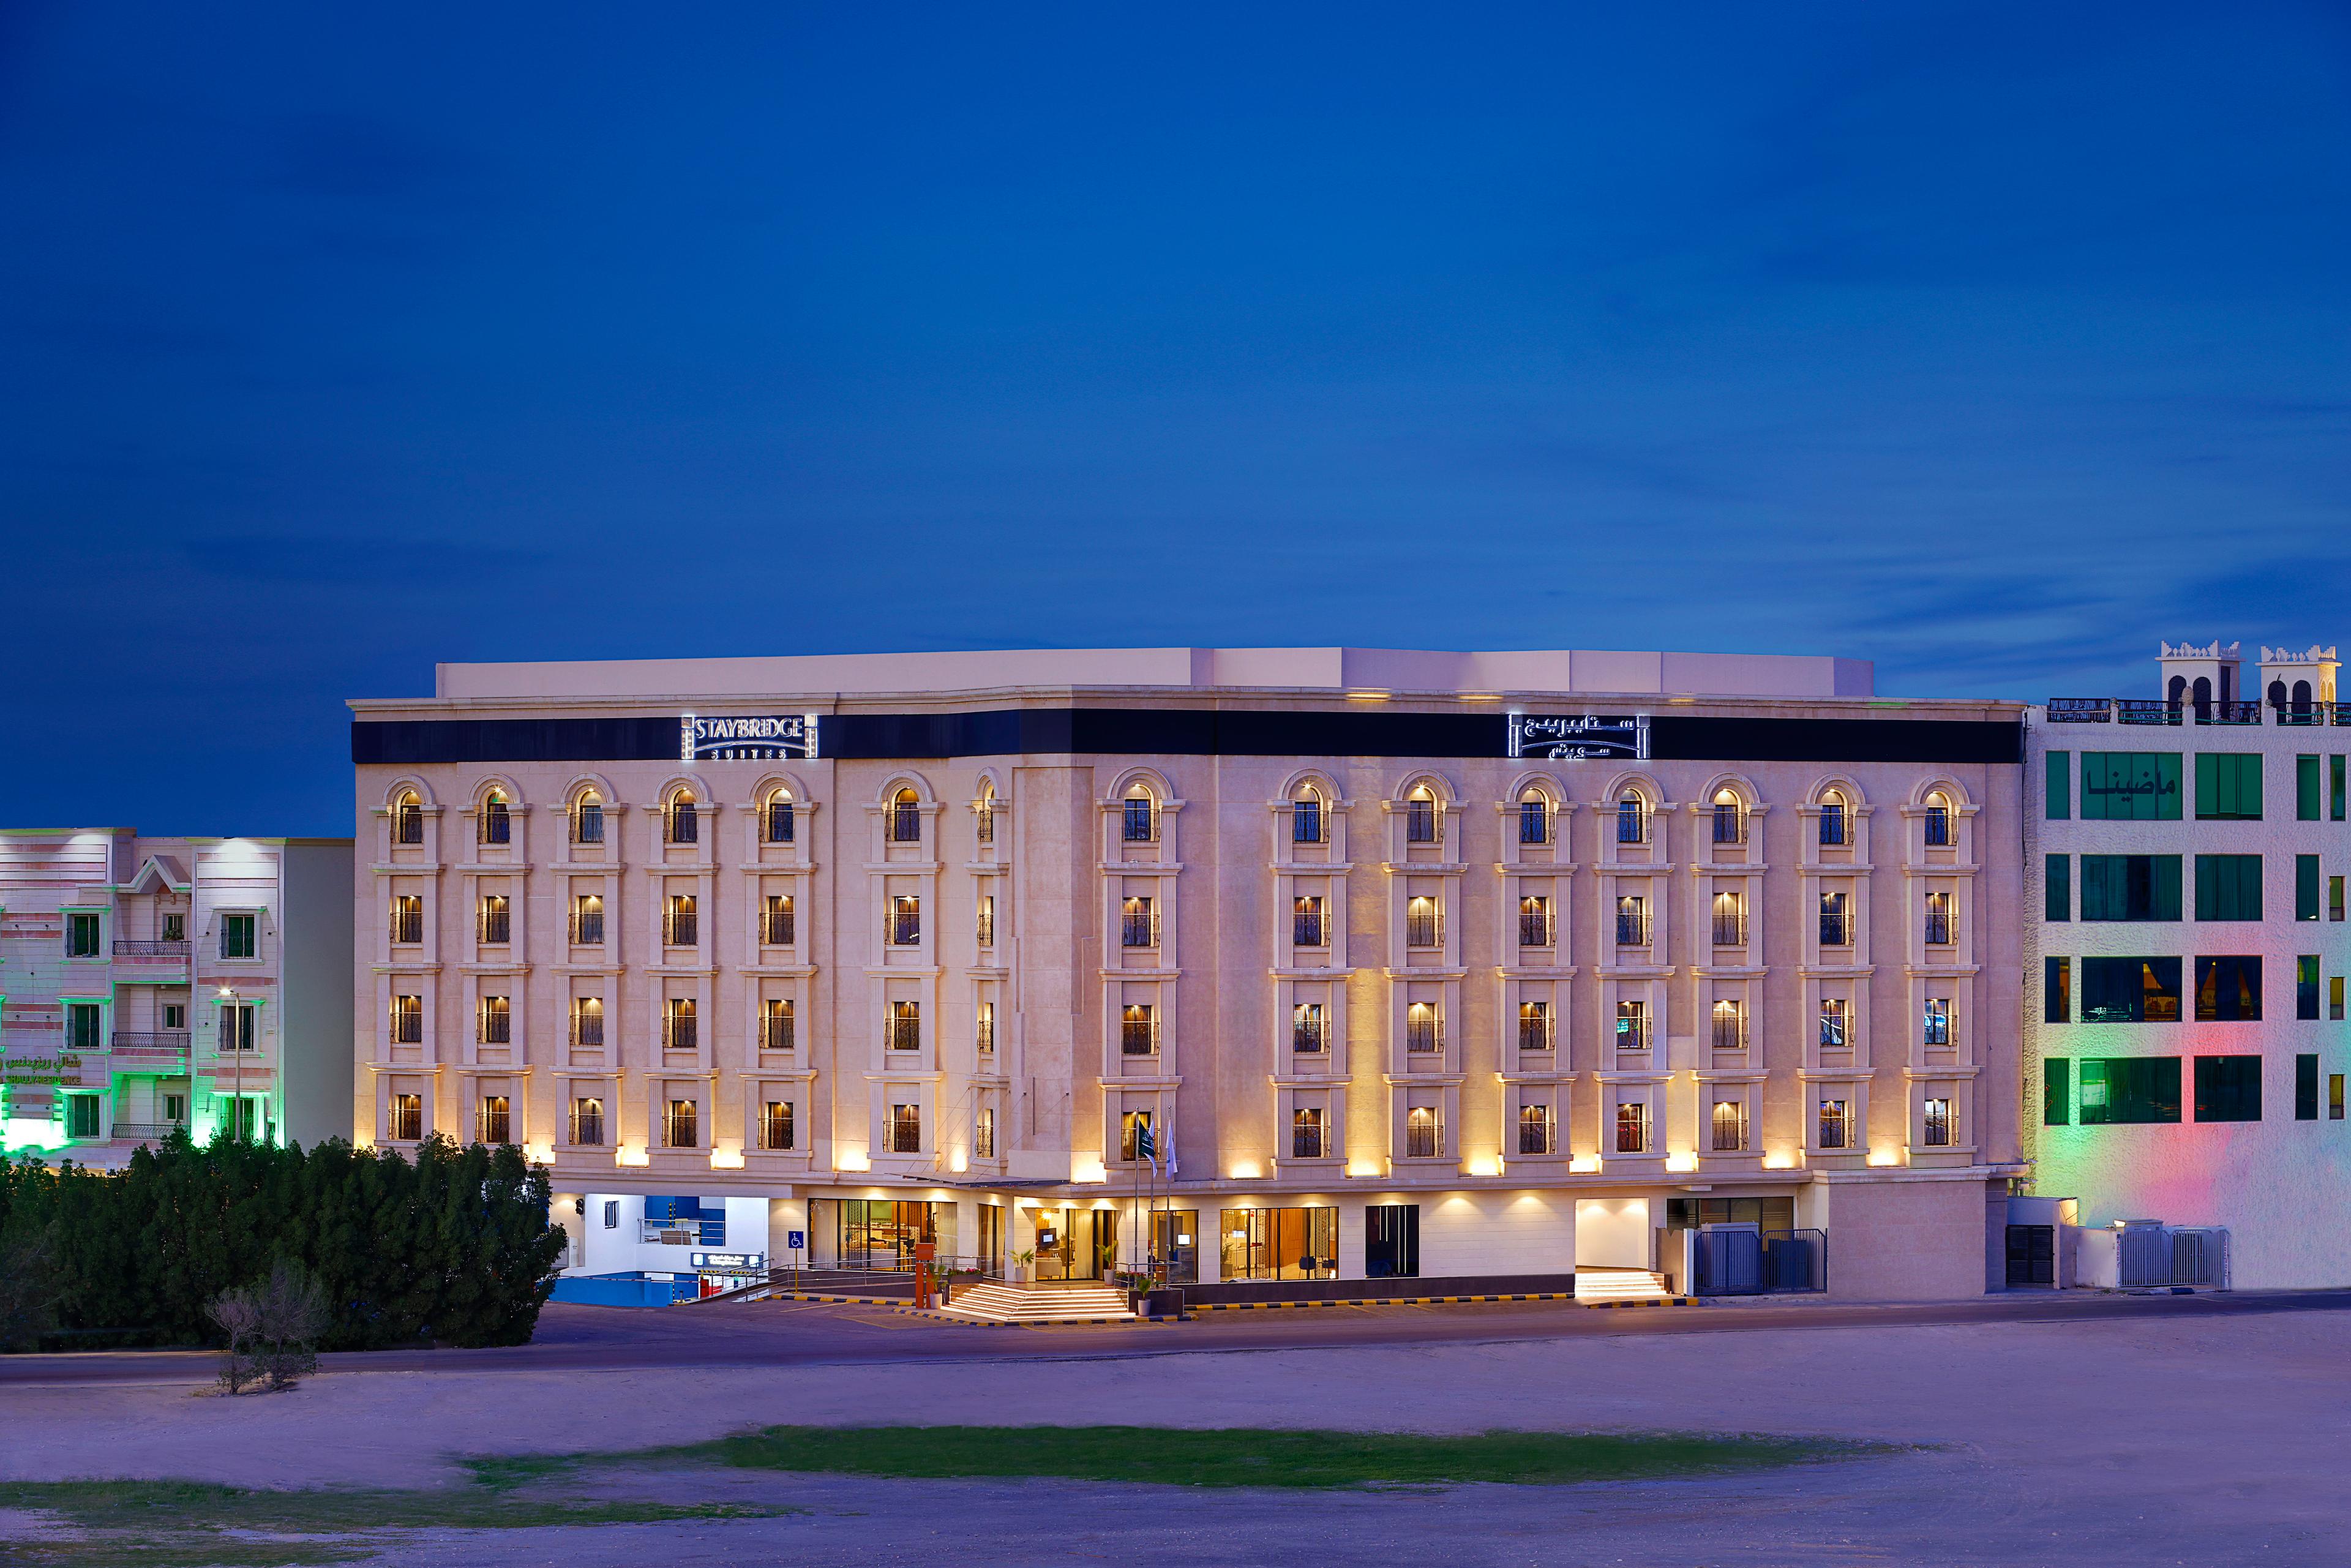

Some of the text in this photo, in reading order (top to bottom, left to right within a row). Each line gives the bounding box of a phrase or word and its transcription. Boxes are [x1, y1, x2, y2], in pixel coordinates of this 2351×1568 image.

[695, 718, 802, 738] STAYBRIDGE
[711, 749, 787, 760] SUITES
[2087, 770, 2176, 802] ماضينا
[53, 1055, 81, 1073] شالي
